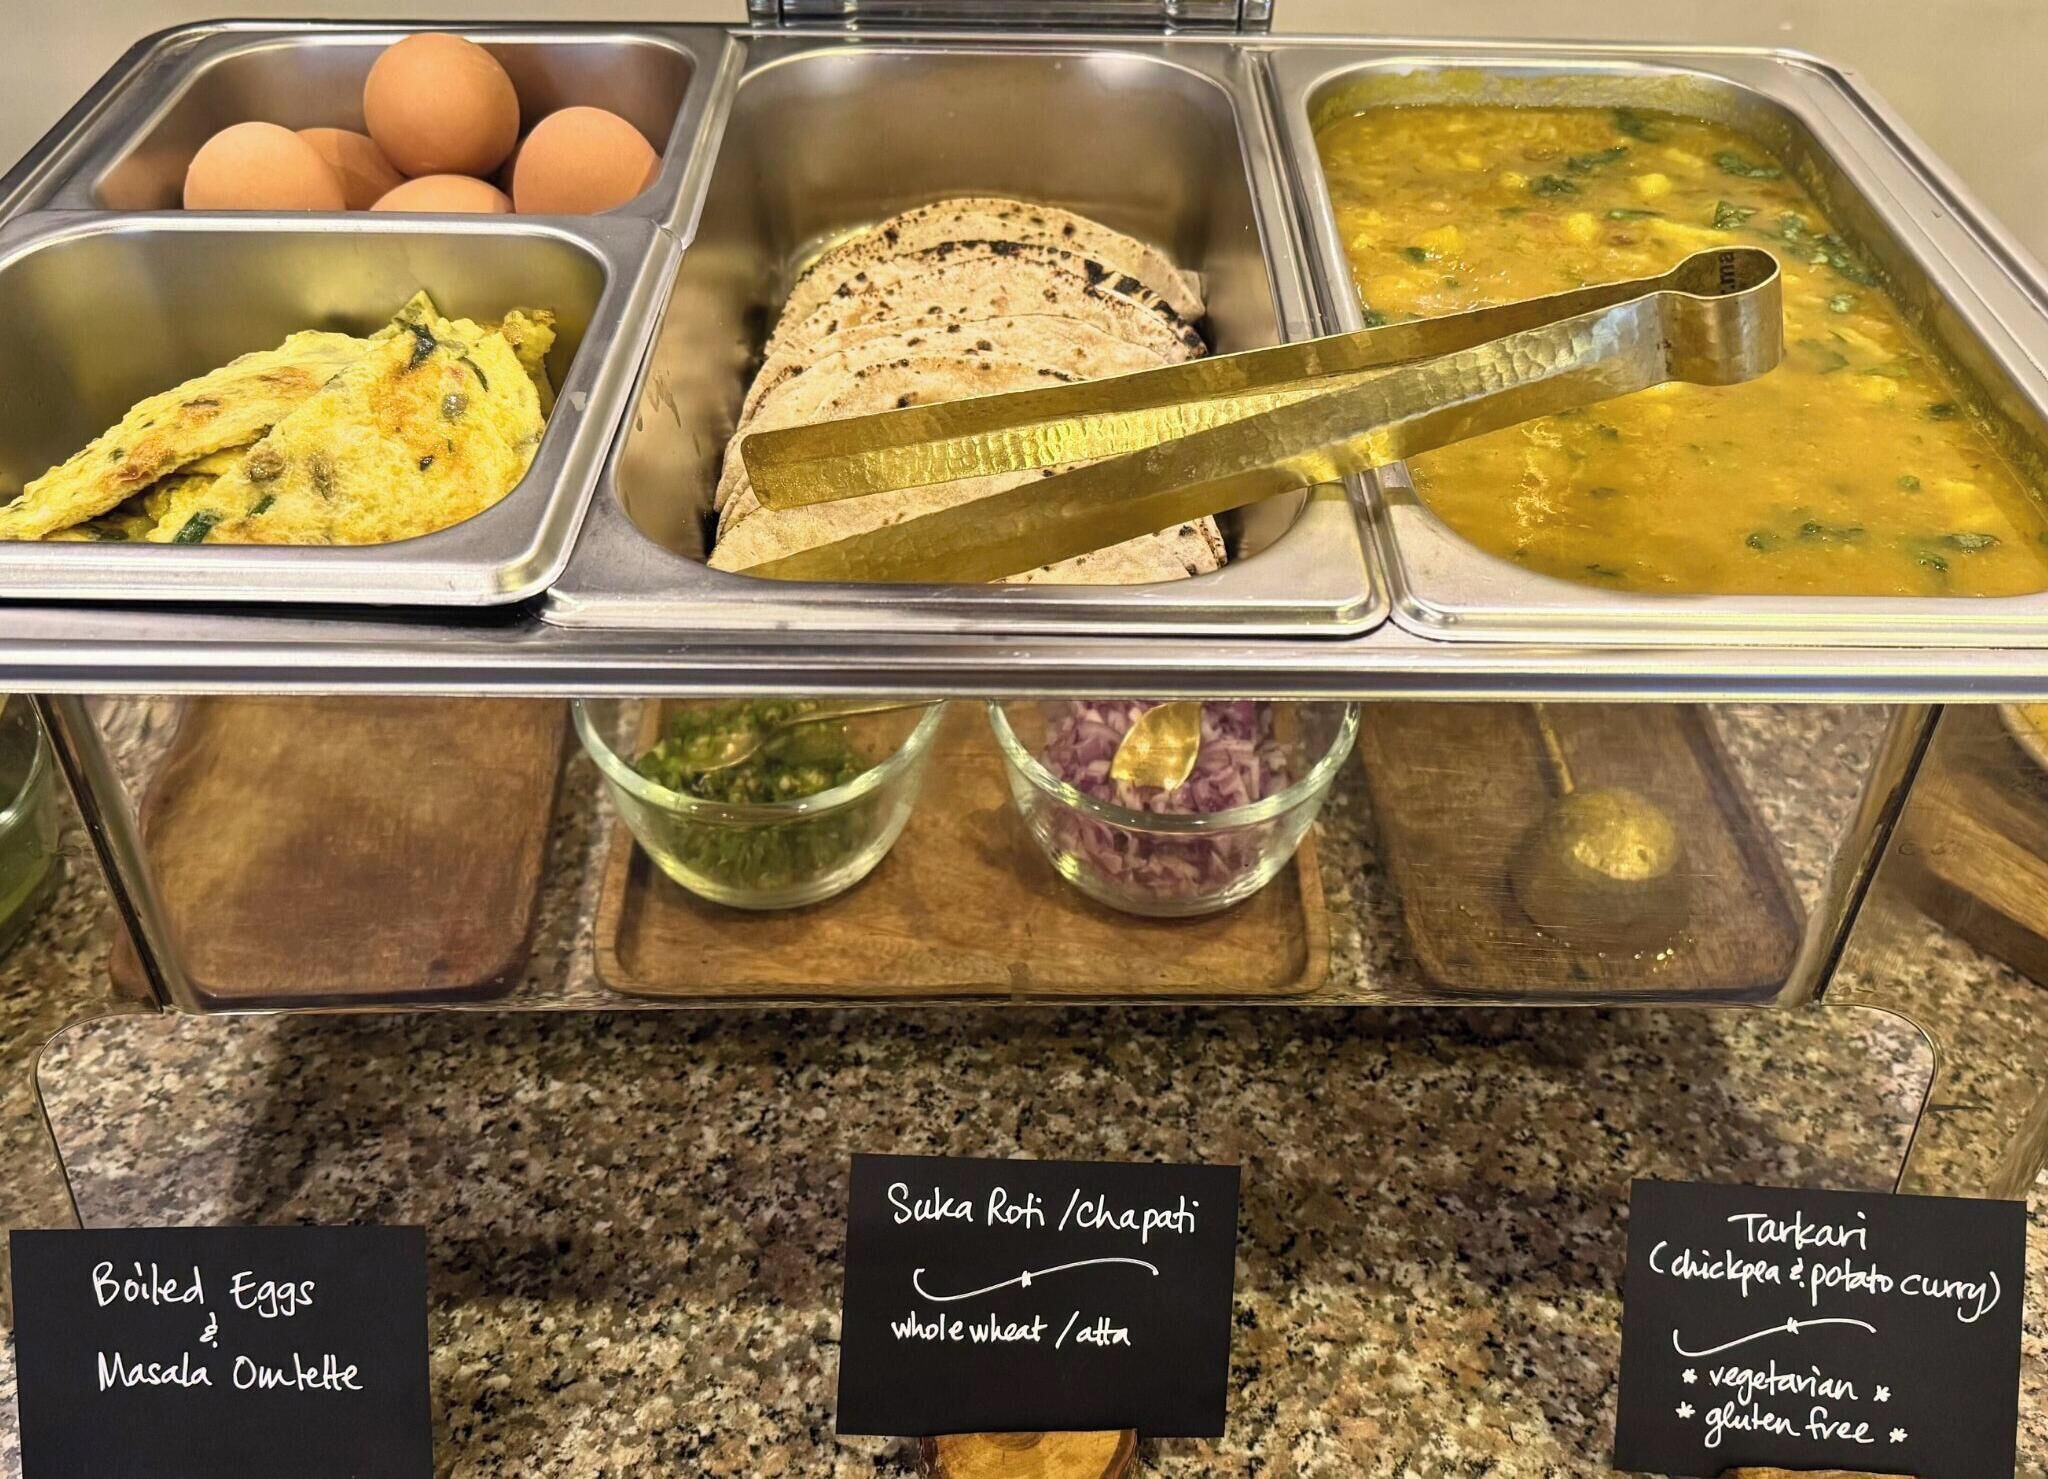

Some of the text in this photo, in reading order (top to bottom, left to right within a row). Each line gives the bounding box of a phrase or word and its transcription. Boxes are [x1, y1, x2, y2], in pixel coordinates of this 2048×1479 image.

[887, 1182, 974, 1225] Suka
[987, 1186, 1046, 1230] Roti
[1727, 1210, 1868, 1251] Tarkari
[92, 1261, 315, 1319] Boiled Eggs
[1810, 1257, 1894, 1307] potato
[890, 1310, 965, 1341] whole
[968, 1312, 1049, 1344] wheat
[97, 1351, 364, 1392] Masala Omlette
[1709, 1359, 1859, 1407] vegetarian
[1704, 1400, 1875, 1449] gluten free
